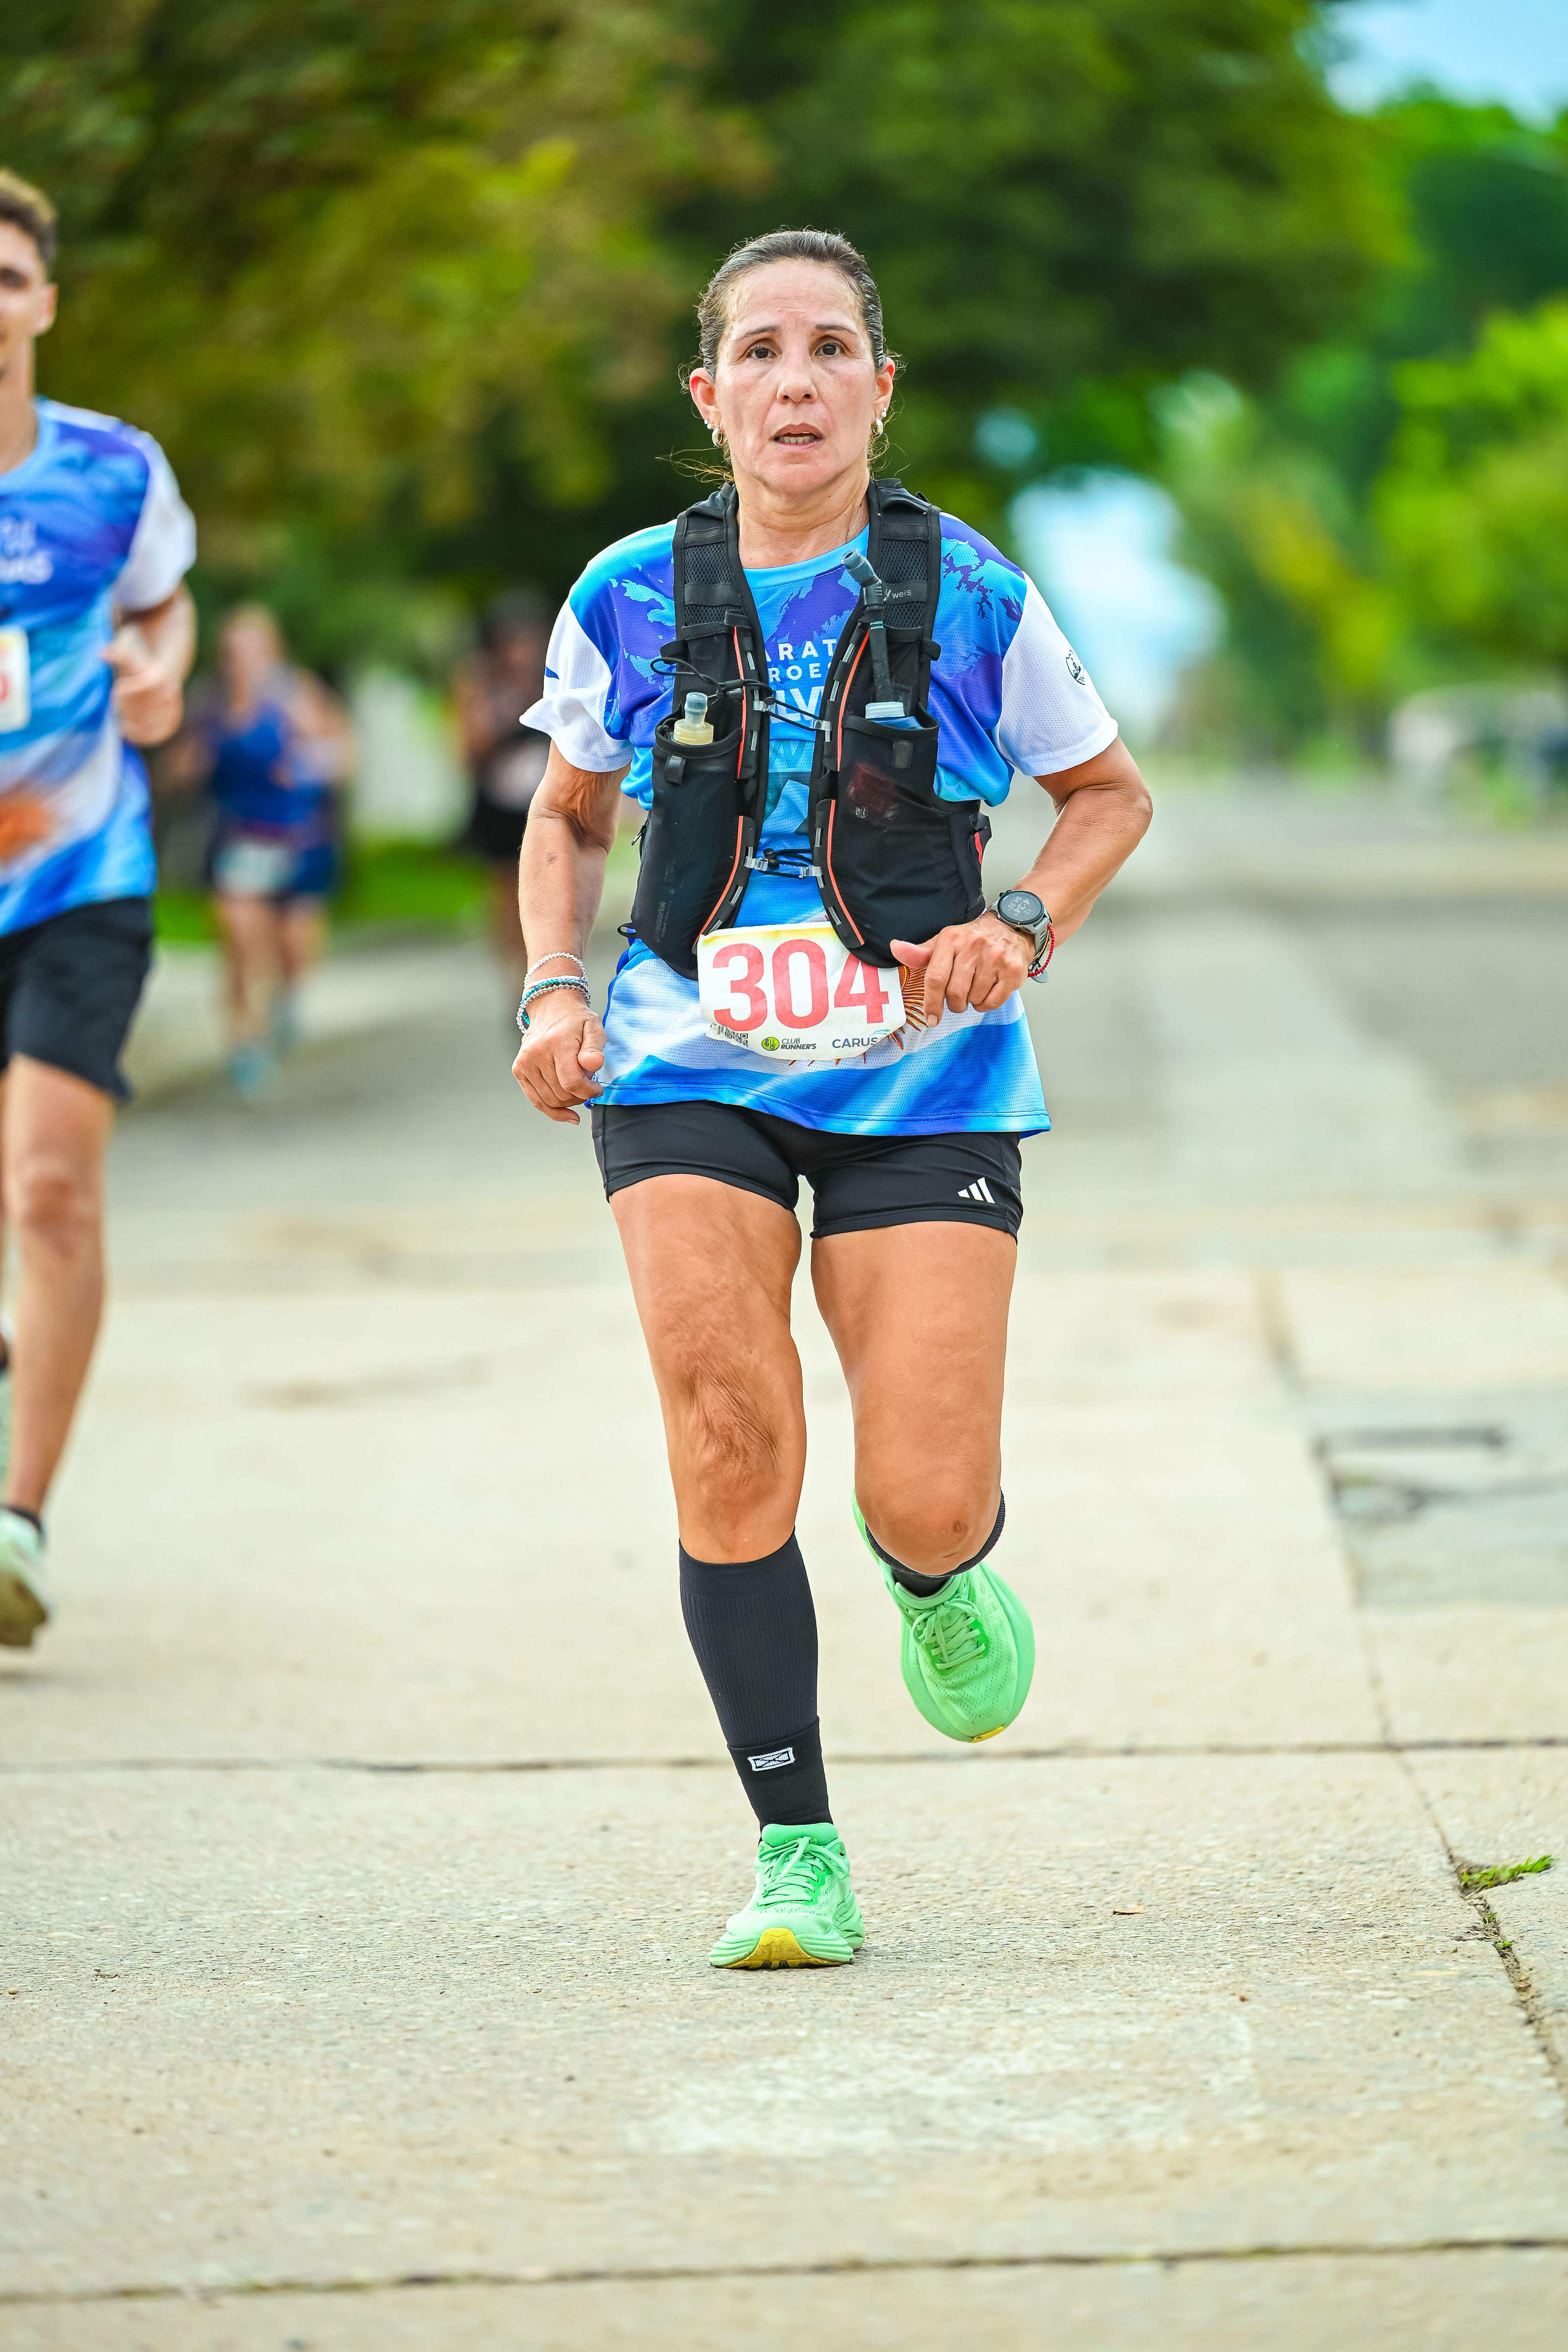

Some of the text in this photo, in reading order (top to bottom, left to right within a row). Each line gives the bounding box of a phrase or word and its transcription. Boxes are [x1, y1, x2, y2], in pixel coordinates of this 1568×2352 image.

[771, 686, 824, 724] LV
[712, 939, 890, 1031] 304
[832, 1037, 884, 1048] CARUS
